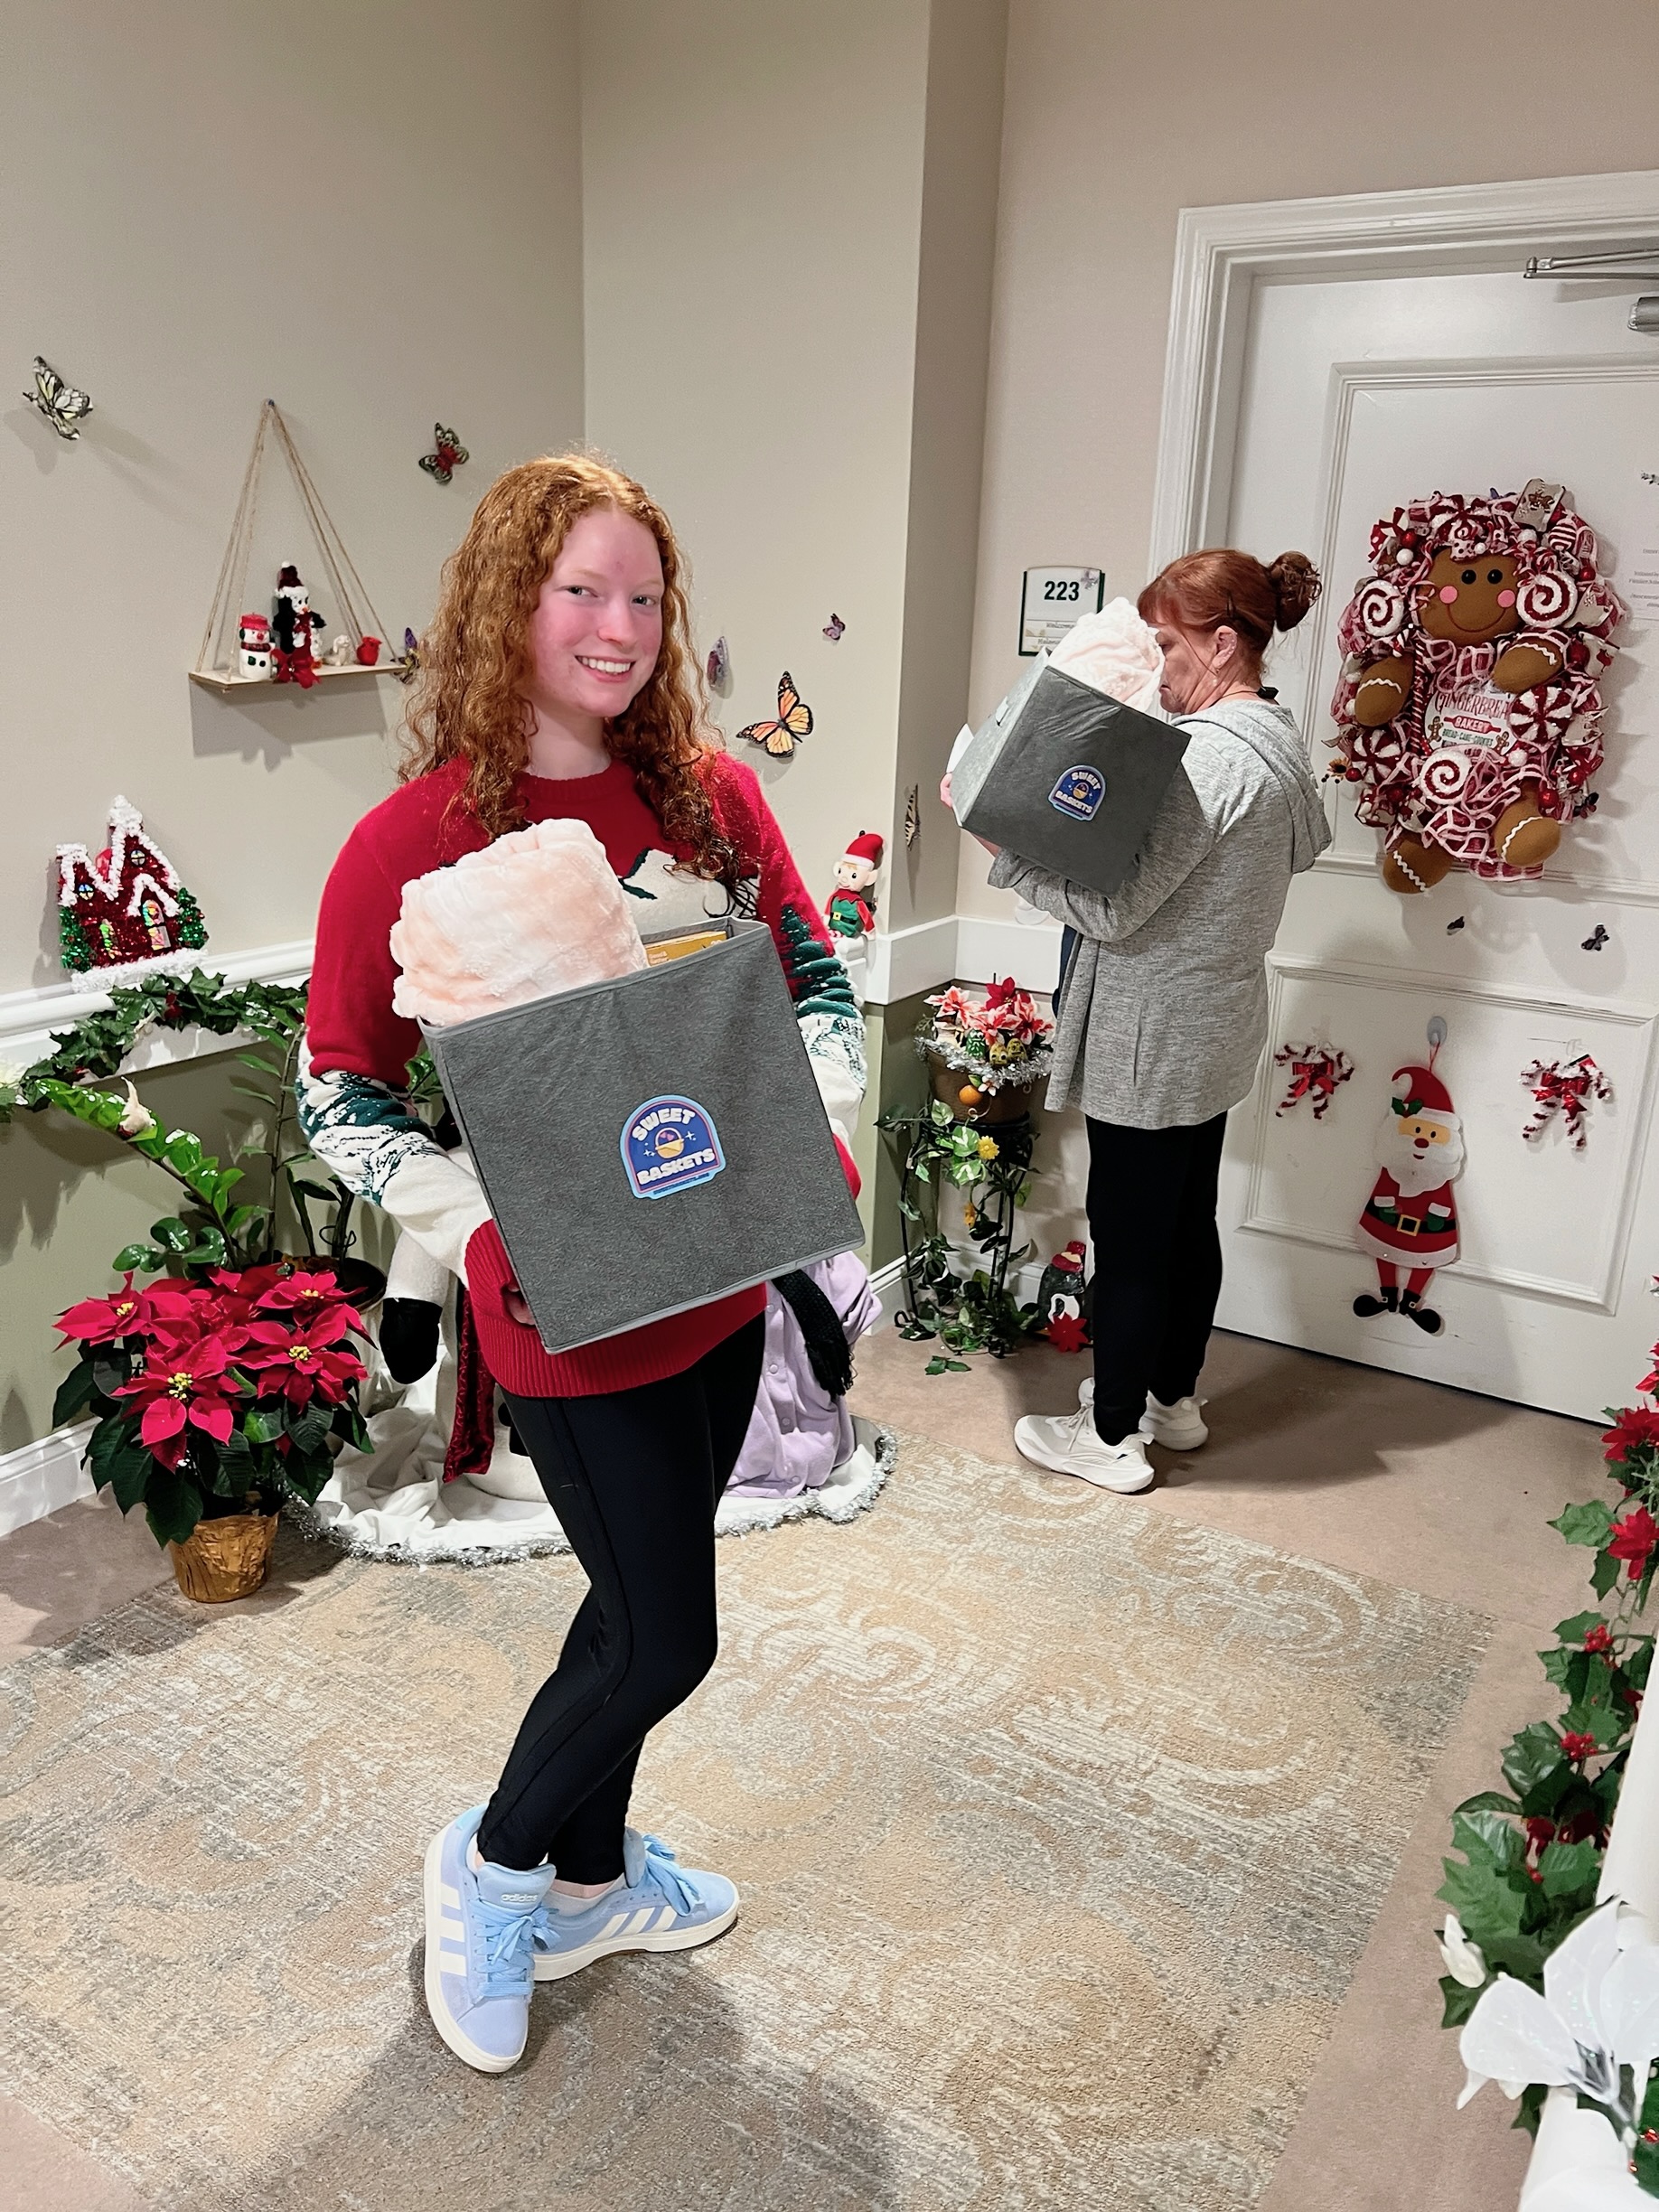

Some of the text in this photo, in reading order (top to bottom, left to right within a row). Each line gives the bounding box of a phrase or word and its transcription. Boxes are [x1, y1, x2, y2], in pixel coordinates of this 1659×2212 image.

[1044, 580, 1080, 601] 223
[1434, 690, 1509, 719] GINGERBREA
[1454, 717, 1489, 734] BAKERY
[1071, 771, 1101, 791] SWEET
[1054, 790, 1093, 813] BASKETS
[632, 1107, 696, 1141] SWEET
[636, 1148, 716, 1186] BASKETS
[501, 1893, 539, 1903] adidas
